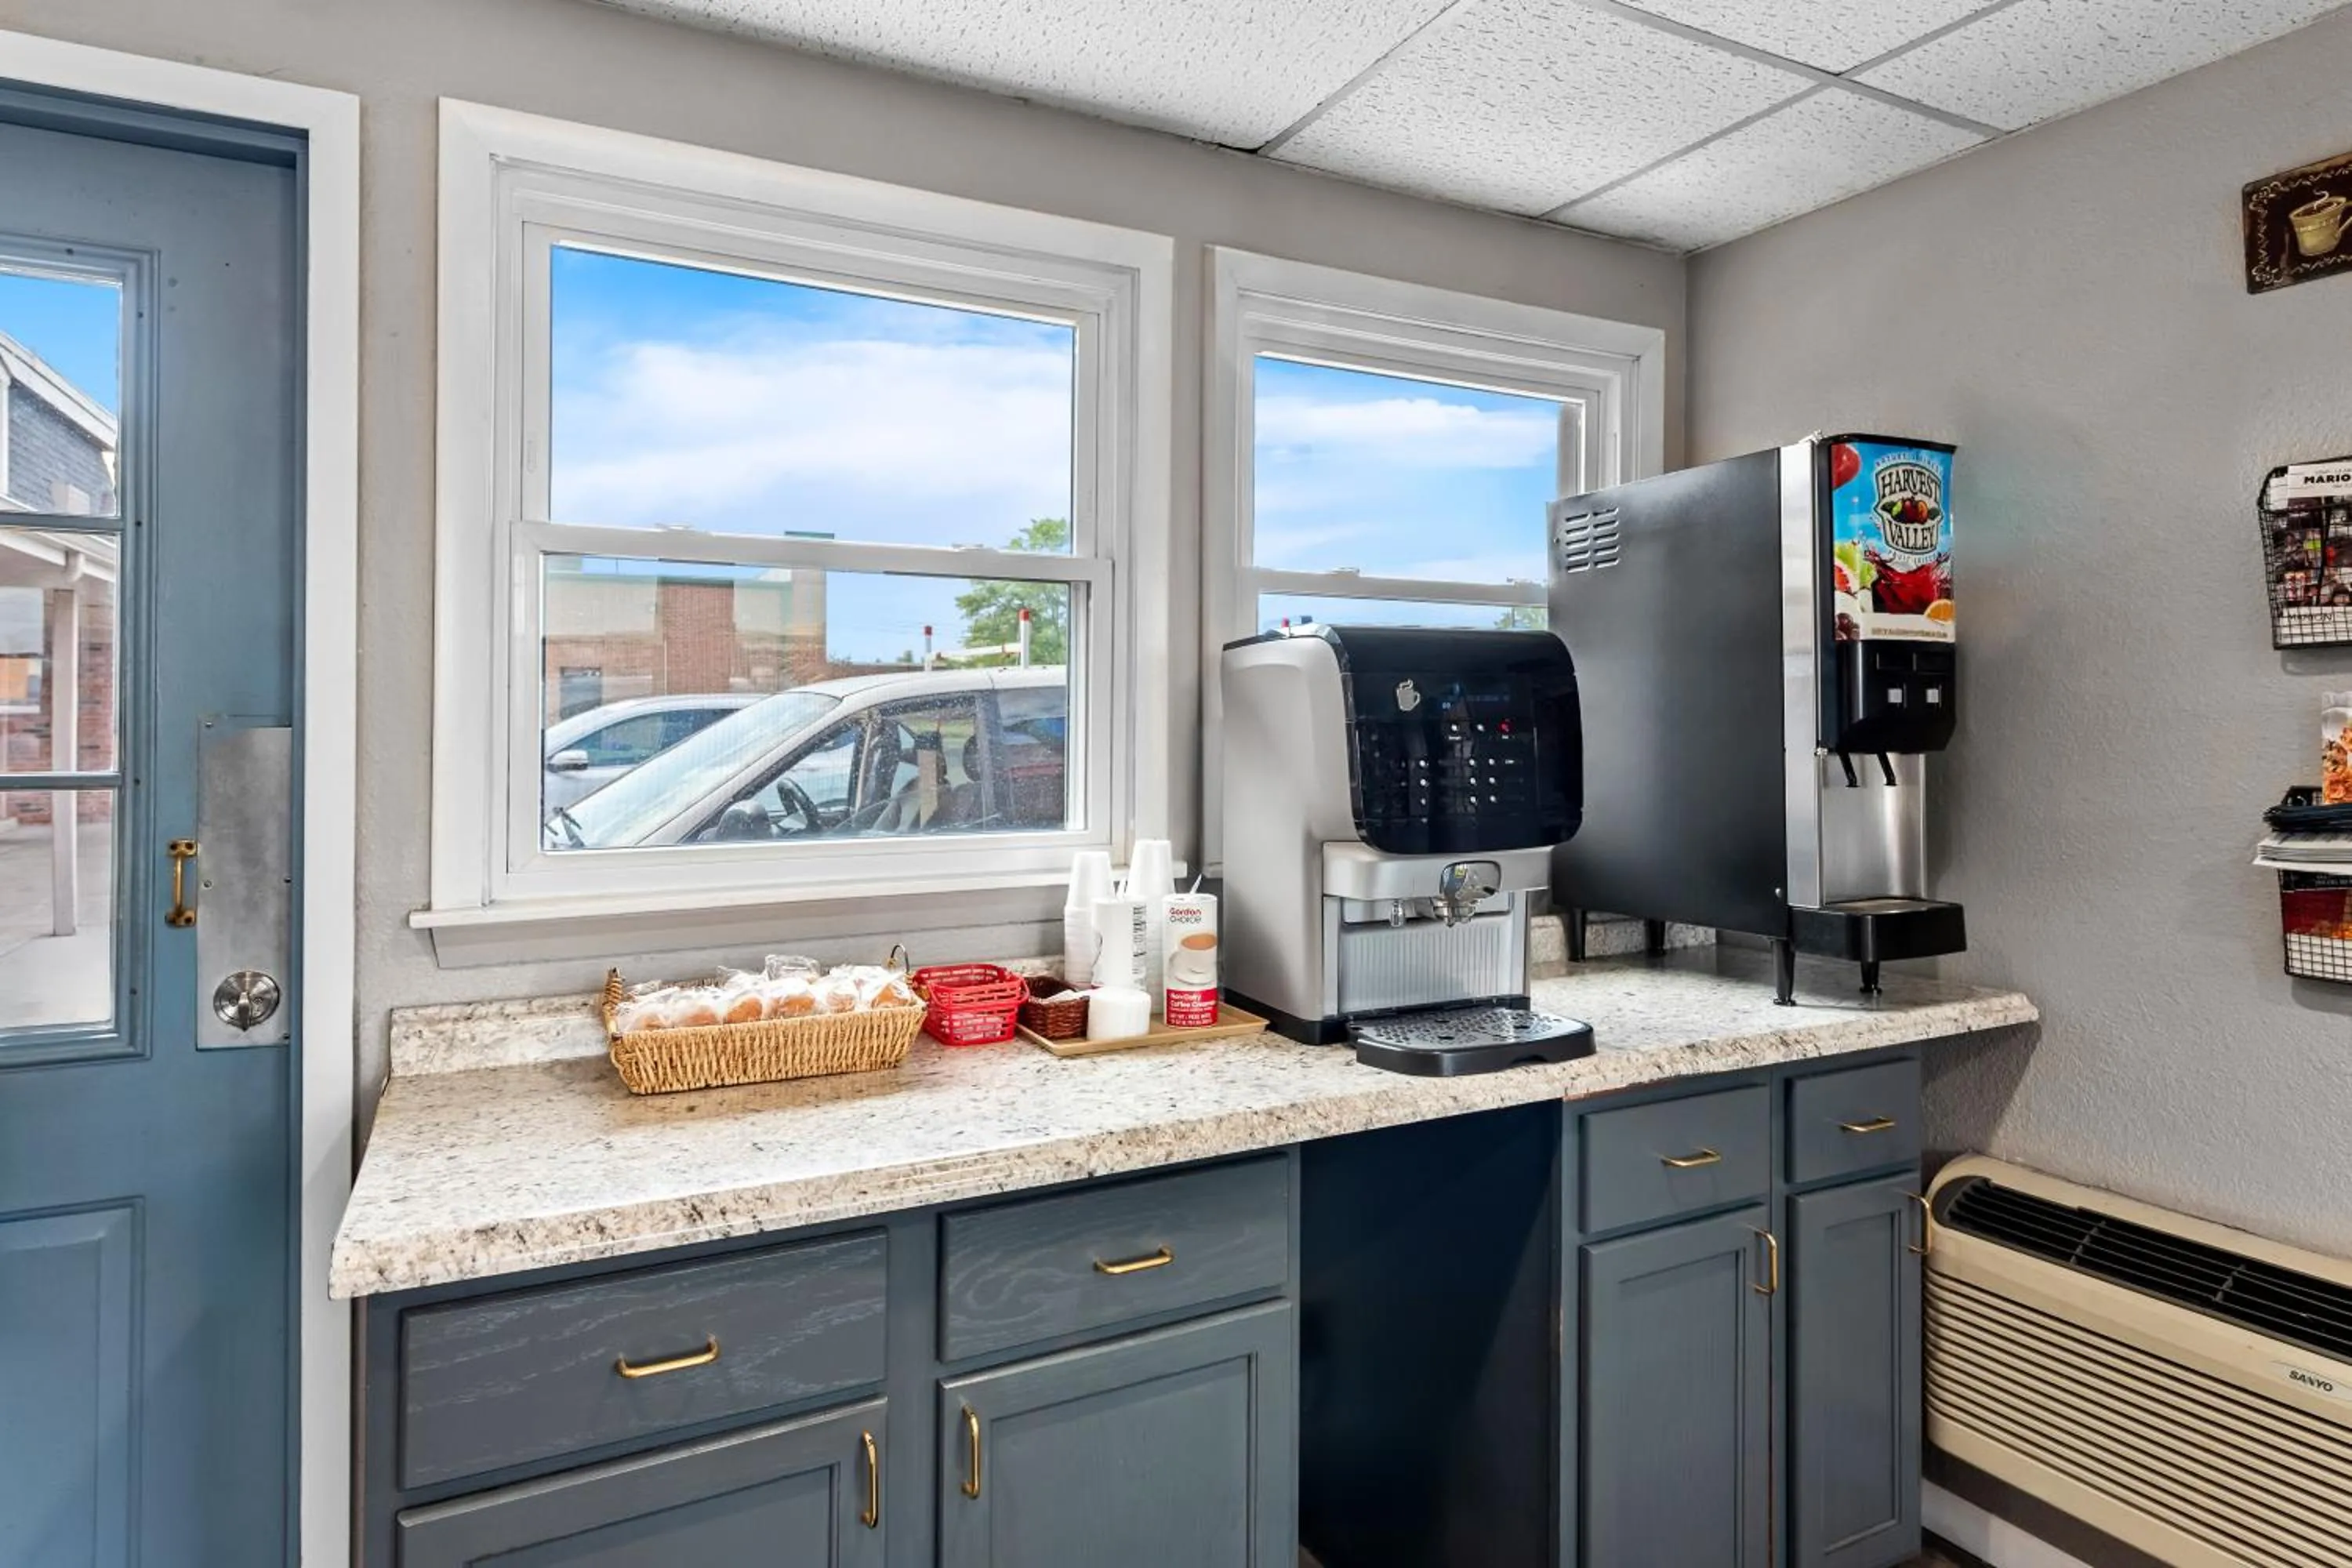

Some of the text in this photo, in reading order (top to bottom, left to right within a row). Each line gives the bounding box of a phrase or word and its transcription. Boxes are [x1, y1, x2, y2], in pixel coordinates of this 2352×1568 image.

[1881, 469, 1940, 503] HARVEST
[2303, 474, 2351, 484] MARIO
[1888, 520, 1936, 550] VALLEY
[1169, 907, 1202, 916] Gordon
[2289, 1370, 2333, 1392] SANYO
